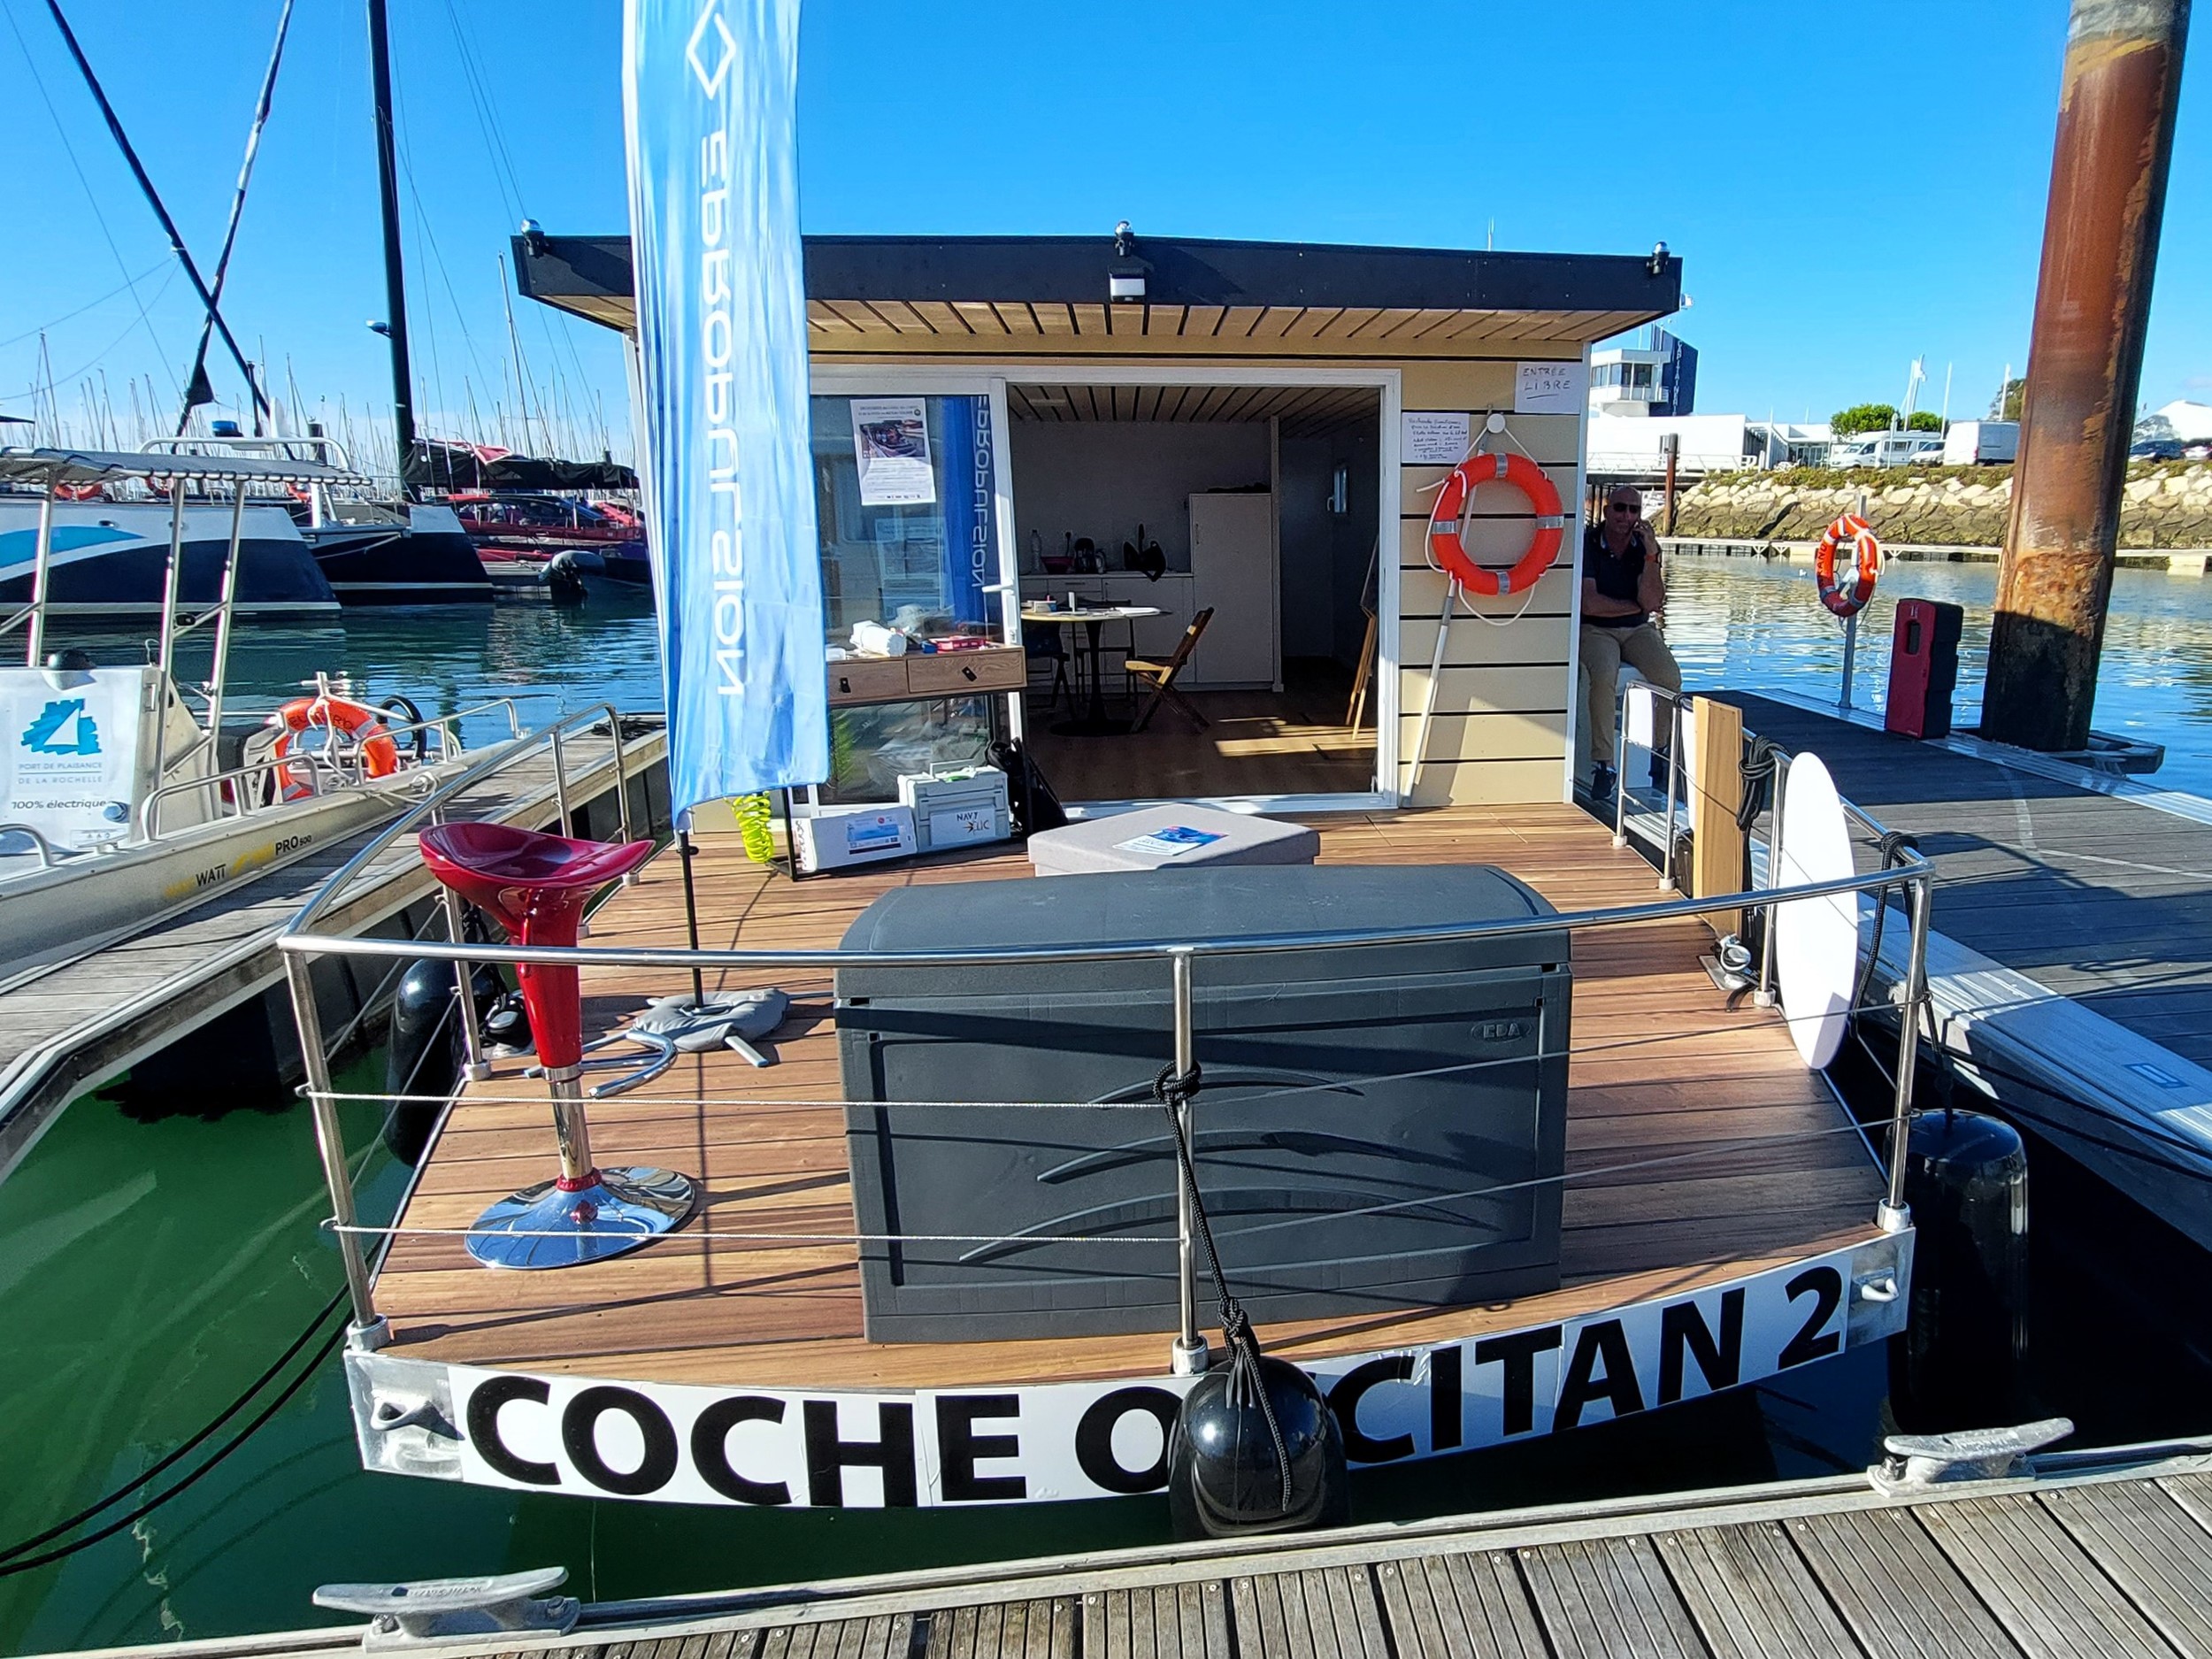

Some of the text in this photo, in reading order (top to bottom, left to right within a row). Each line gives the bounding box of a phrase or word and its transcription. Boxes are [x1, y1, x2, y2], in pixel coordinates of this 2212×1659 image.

[12, 799, 106, 810] 100% électrique
[956, 811, 979, 821] NAVY
[196, 864, 227, 886] WATT
[275, 836, 299, 856] PRO
[1483, 1023, 1521, 1038] EDA
[466, 1266, 1842, 1508] COCHE OCITAN 2
